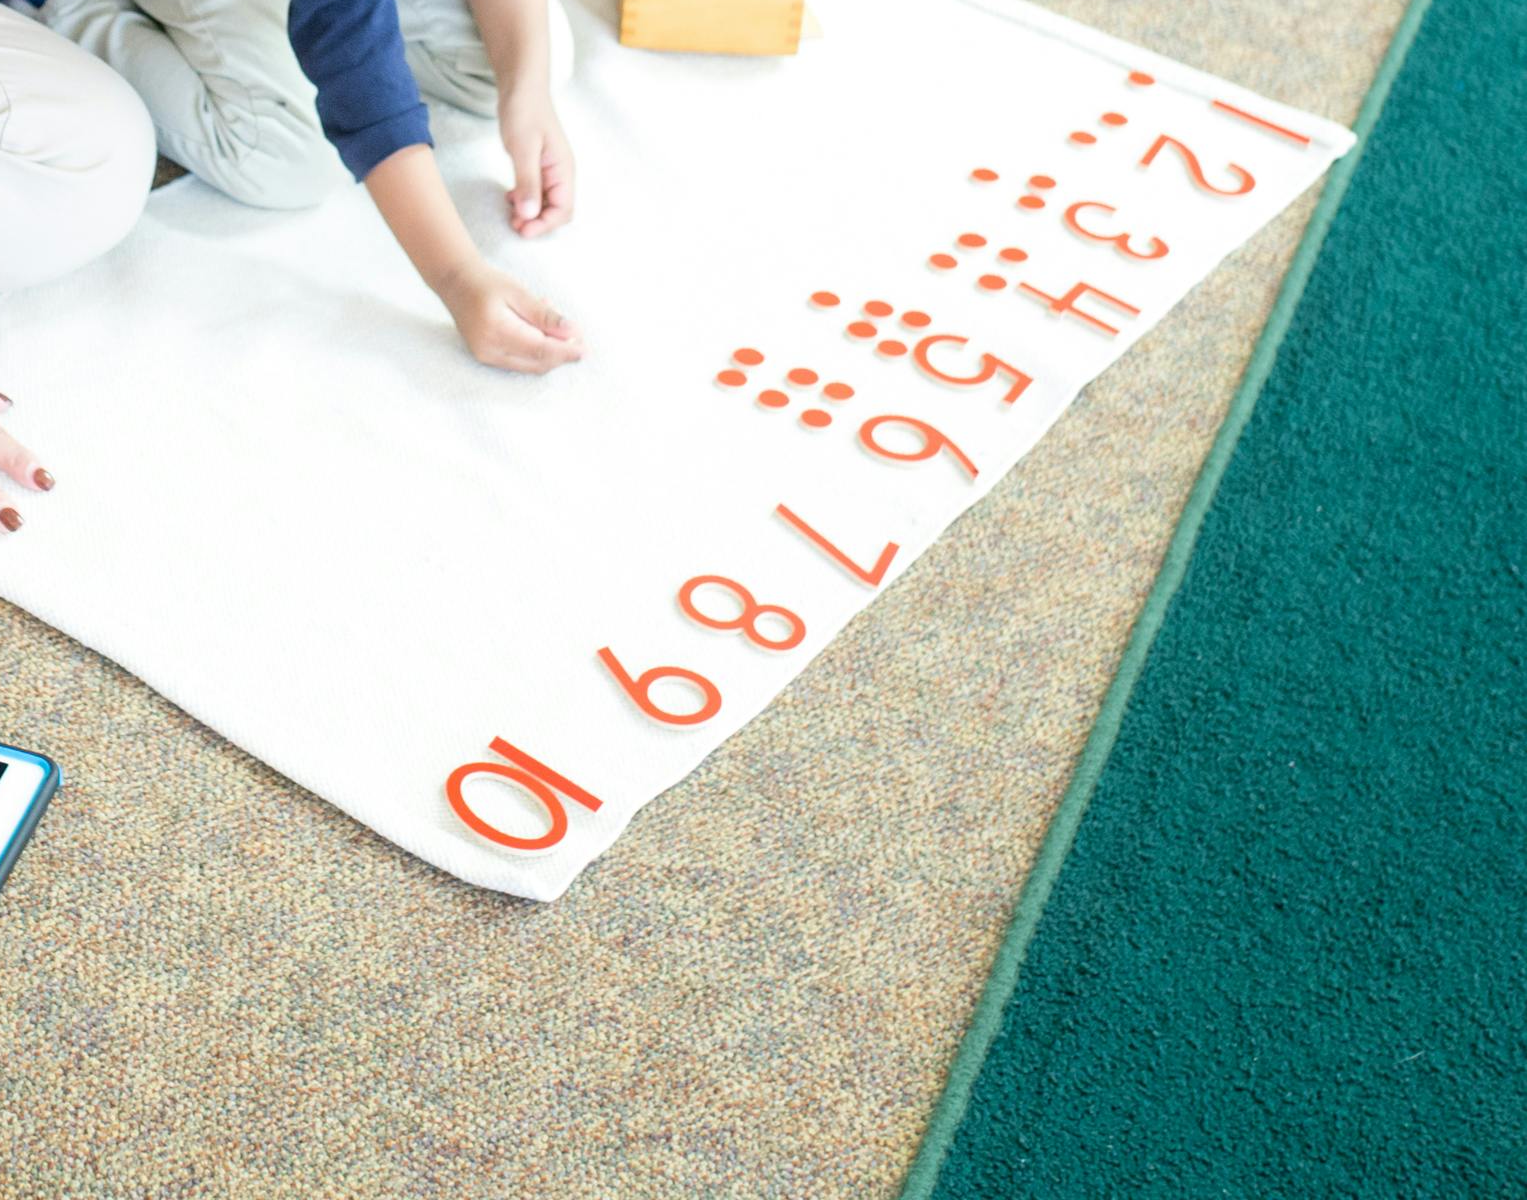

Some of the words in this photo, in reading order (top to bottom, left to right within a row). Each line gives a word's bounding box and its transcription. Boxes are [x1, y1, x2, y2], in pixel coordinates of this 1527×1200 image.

[1211, 99, 1312, 146] 1
[1138, 133, 1256, 197] 2
[1062, 200, 1170, 261] 3
[1018, 280, 1141, 336] 4
[911, 333, 1034, 405] 5
[857, 413, 980, 479] 6
[775, 502, 900, 588] 7
[676, 574, 807, 652] 8
[595, 645, 724, 727] 9
[444, 735, 604, 851] 10
